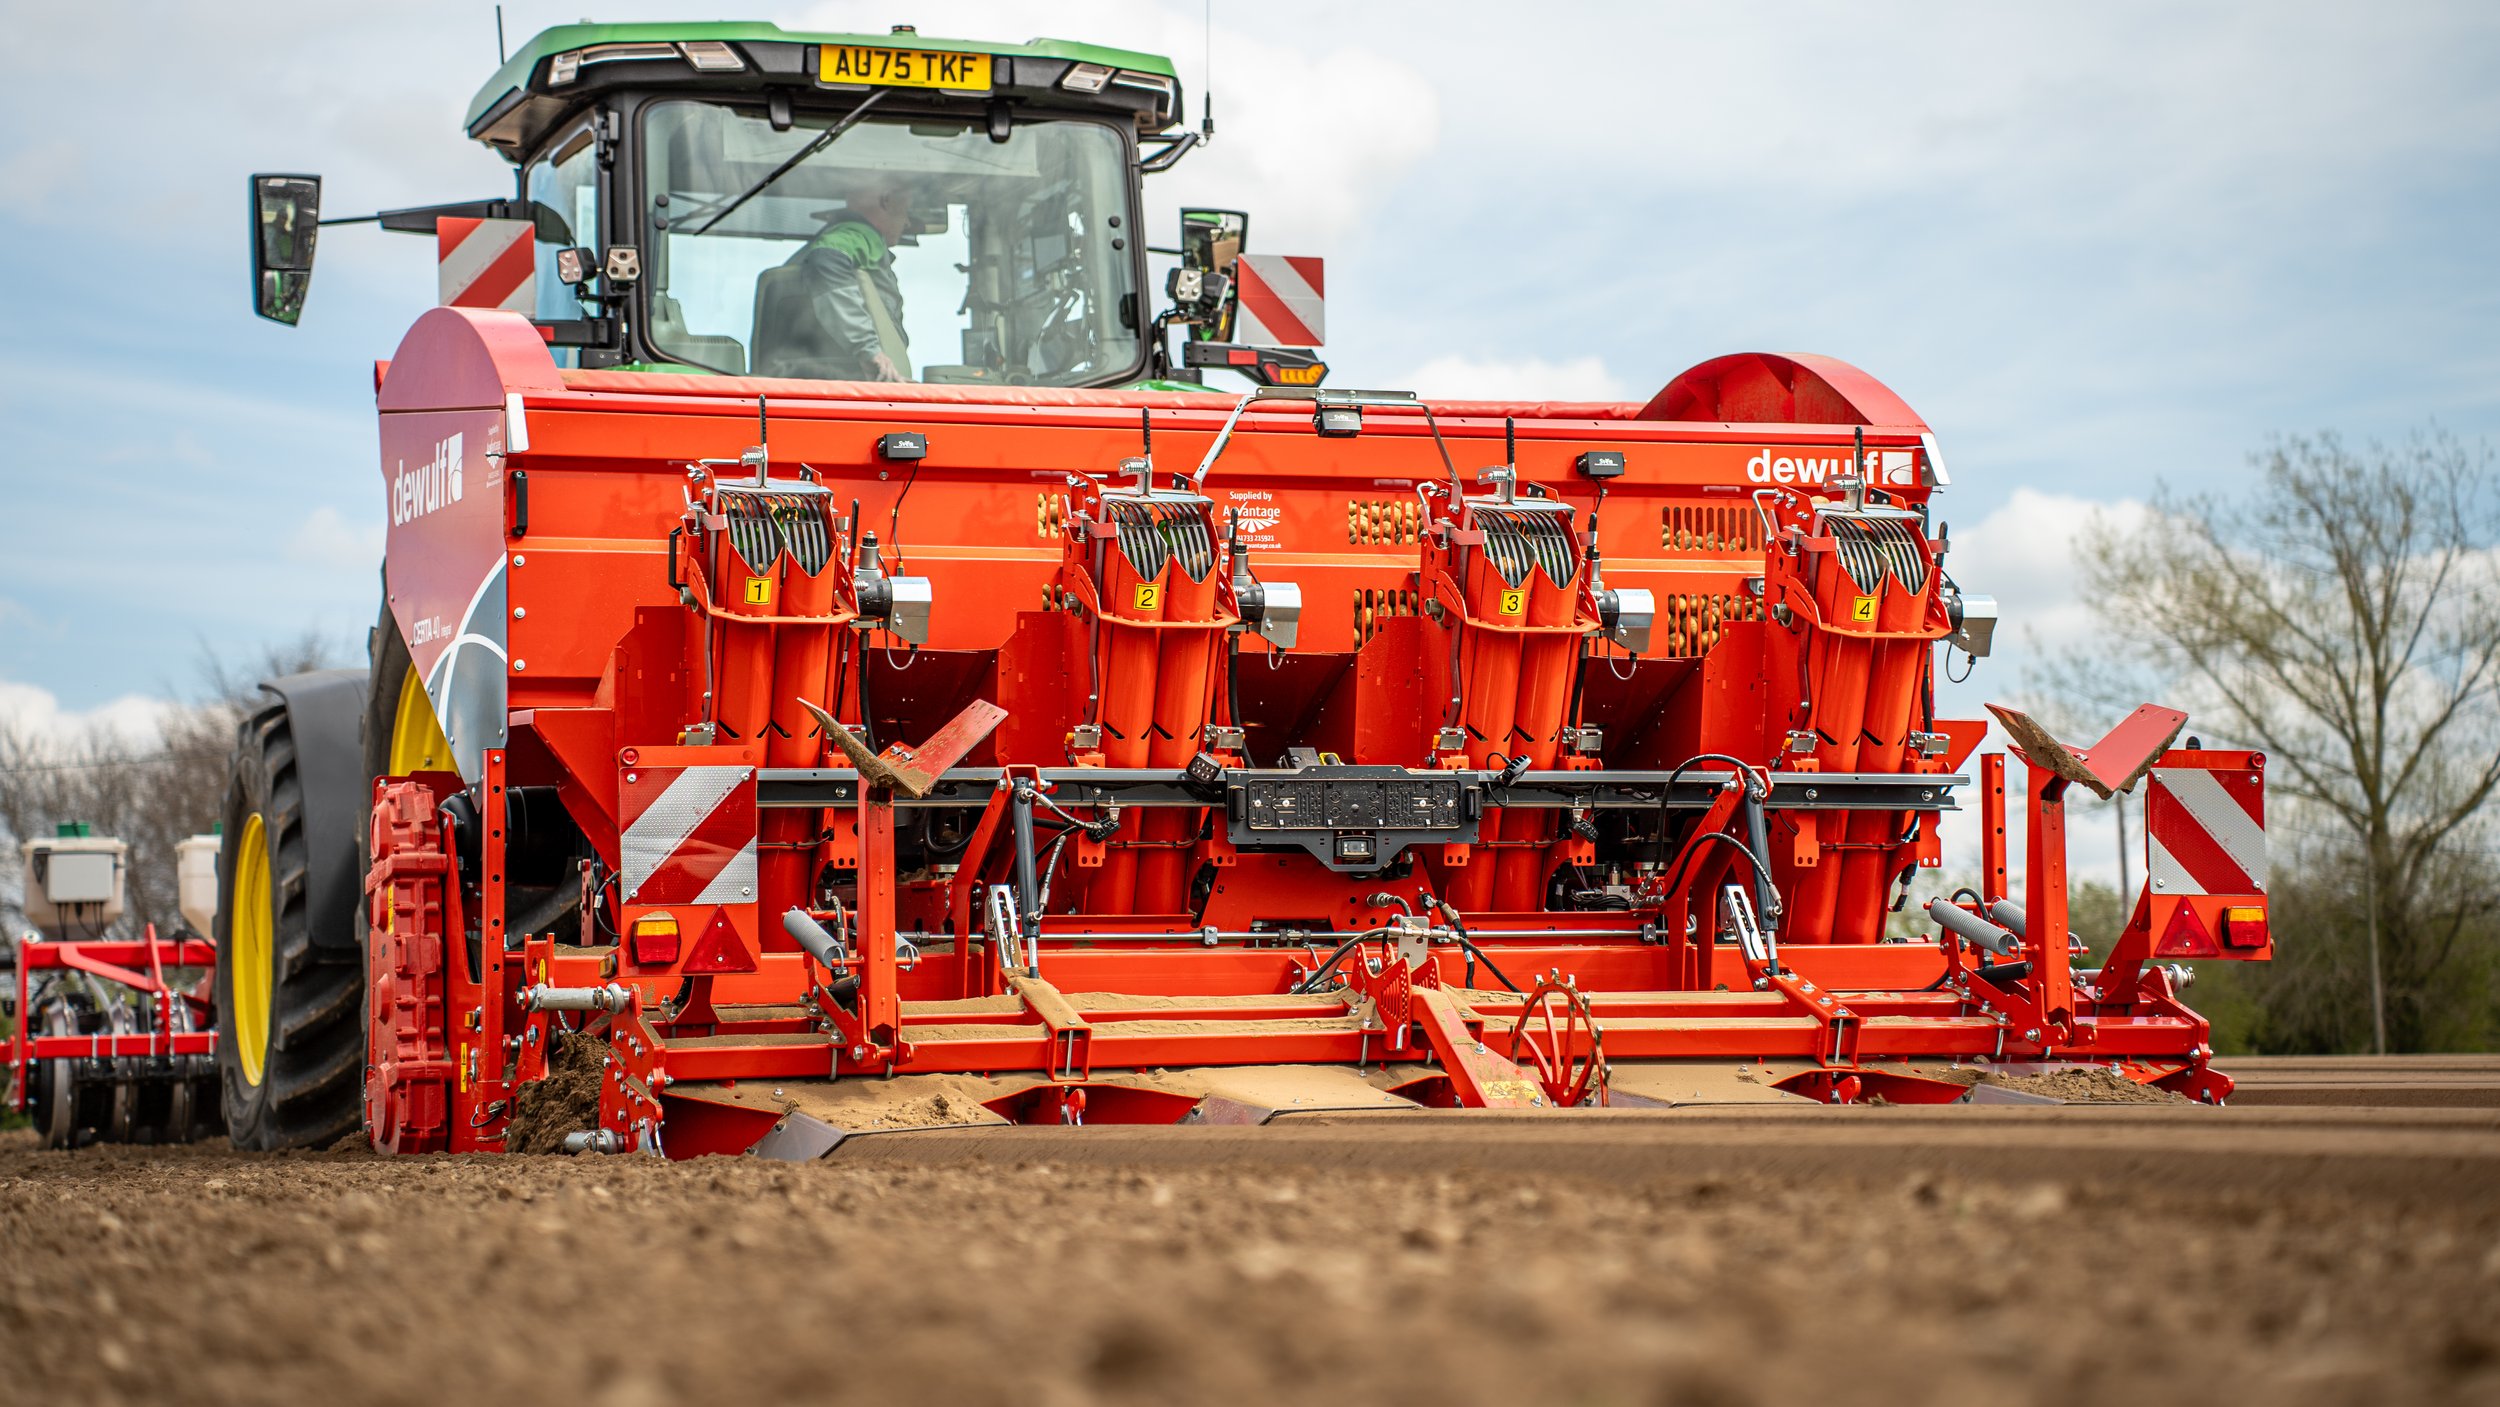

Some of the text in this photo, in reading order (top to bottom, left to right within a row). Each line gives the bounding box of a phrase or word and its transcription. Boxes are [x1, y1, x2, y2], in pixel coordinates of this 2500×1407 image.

[835, 48, 977, 83] AU75 TKF
[1746, 448, 1879, 485] dewuf
[393, 438, 448, 527] dewulf
[1229, 491, 1272, 501] Supplied by
[754, 582, 762, 601] 1
[1140, 588, 1154, 607] 2
[1507, 594, 1519, 612] 3
[1859, 601, 1871, 618] 4
